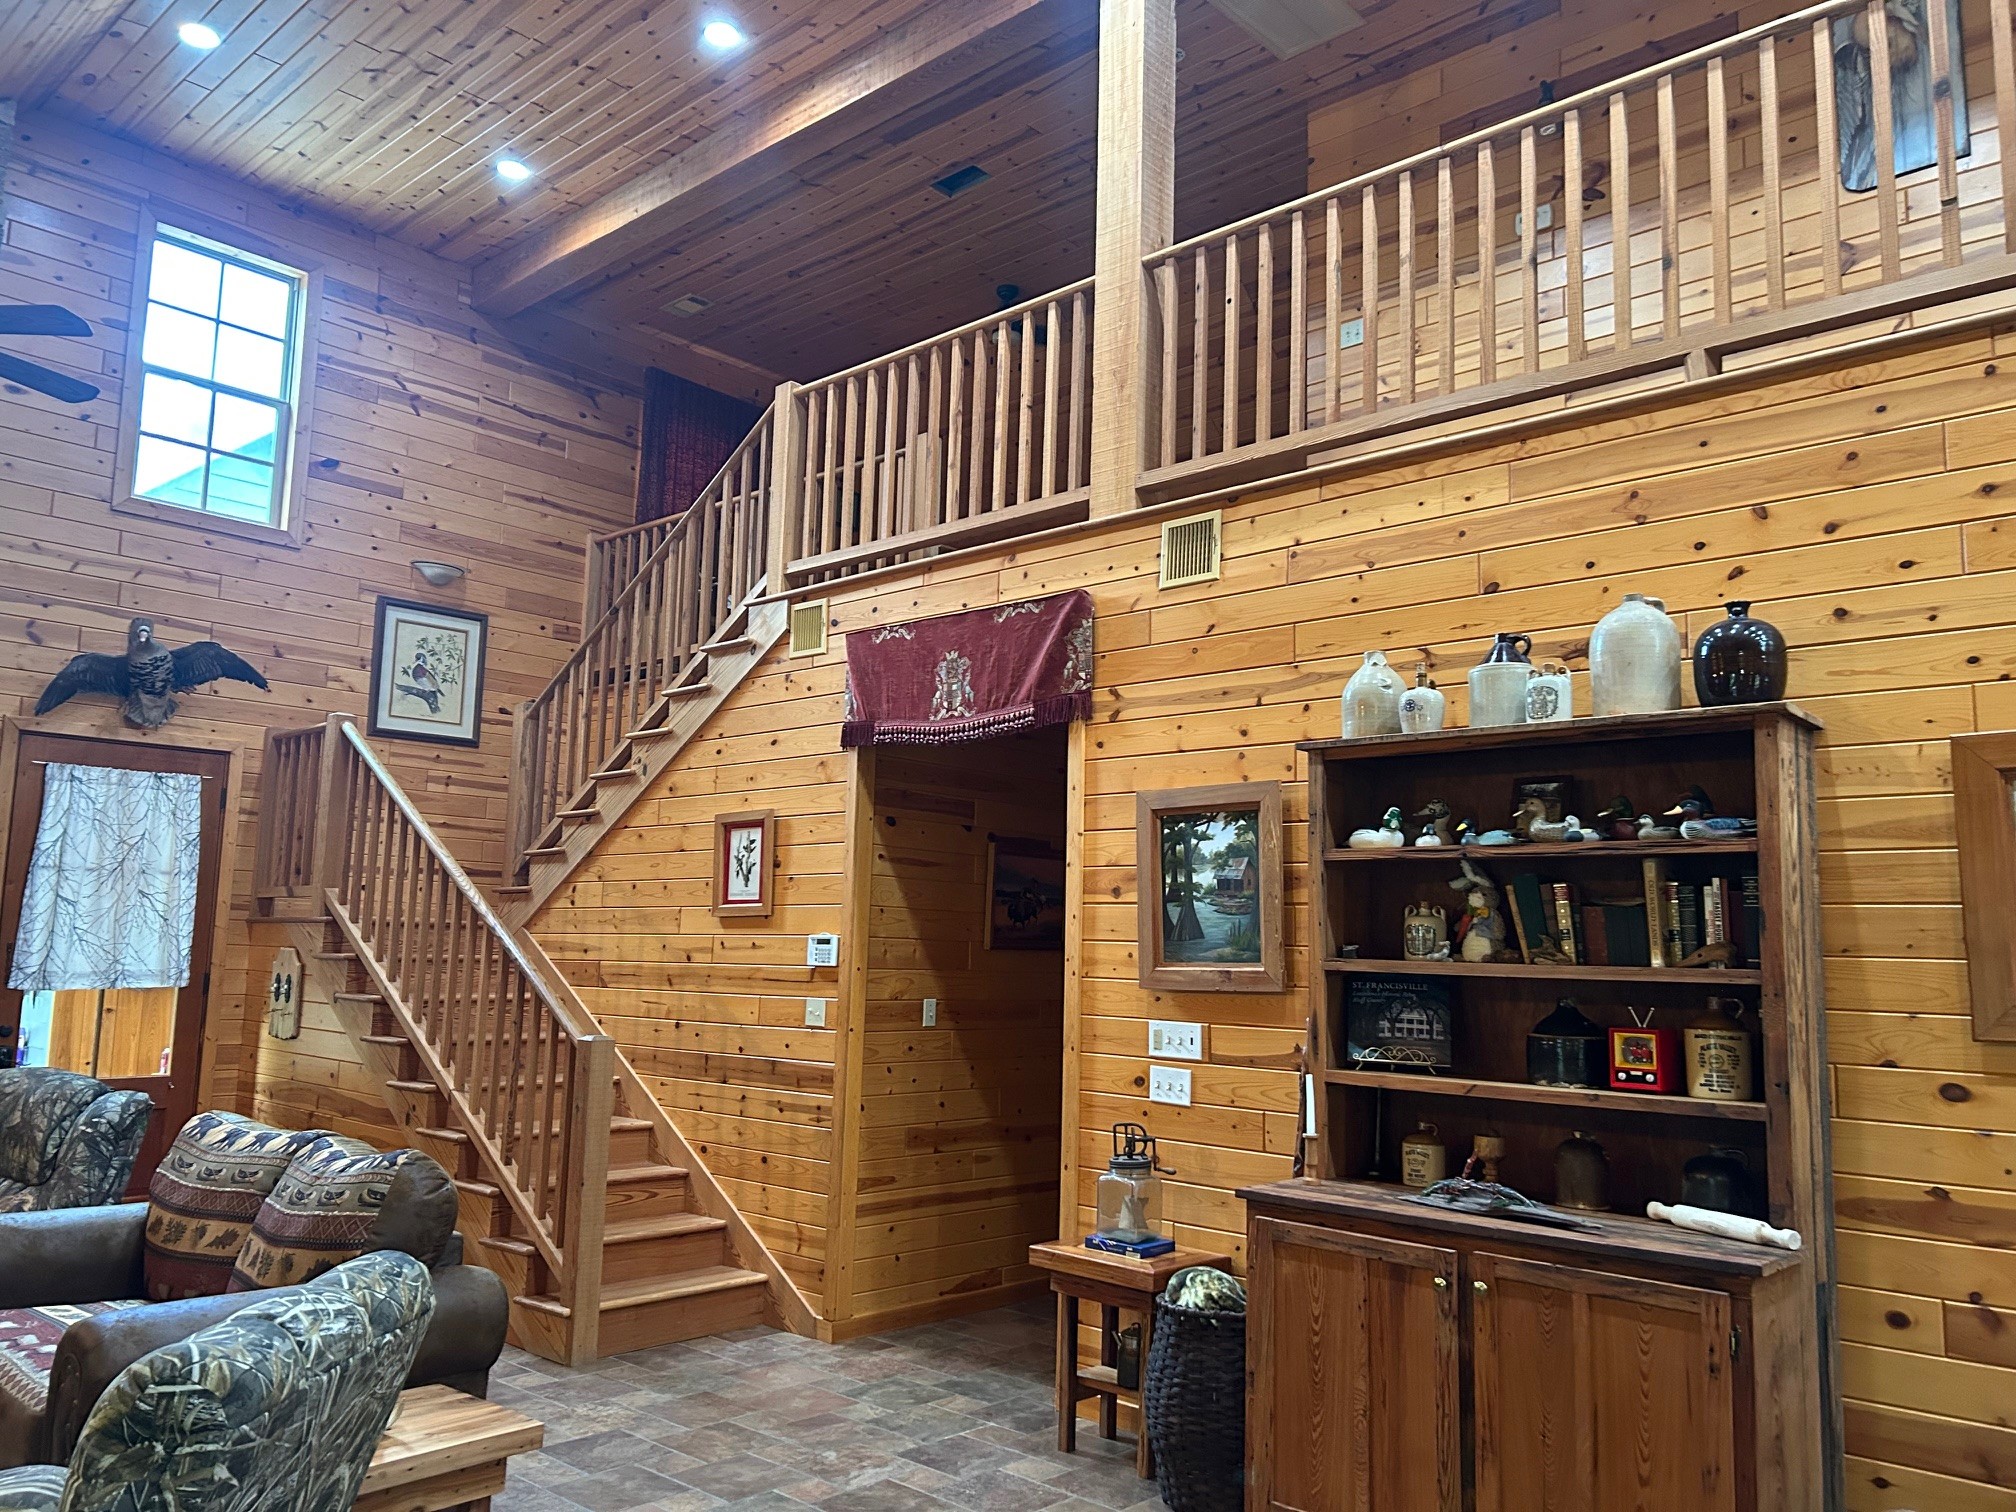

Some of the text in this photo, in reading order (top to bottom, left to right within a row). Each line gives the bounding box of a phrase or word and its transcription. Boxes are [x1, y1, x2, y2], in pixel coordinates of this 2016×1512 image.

[1647, 880, 1655, 895] OLD
[1649, 897, 1657, 922] WORLD
[1713, 901, 1722, 922] BASSET
[1366, 982, 1428, 991] FRANCISVILLE
